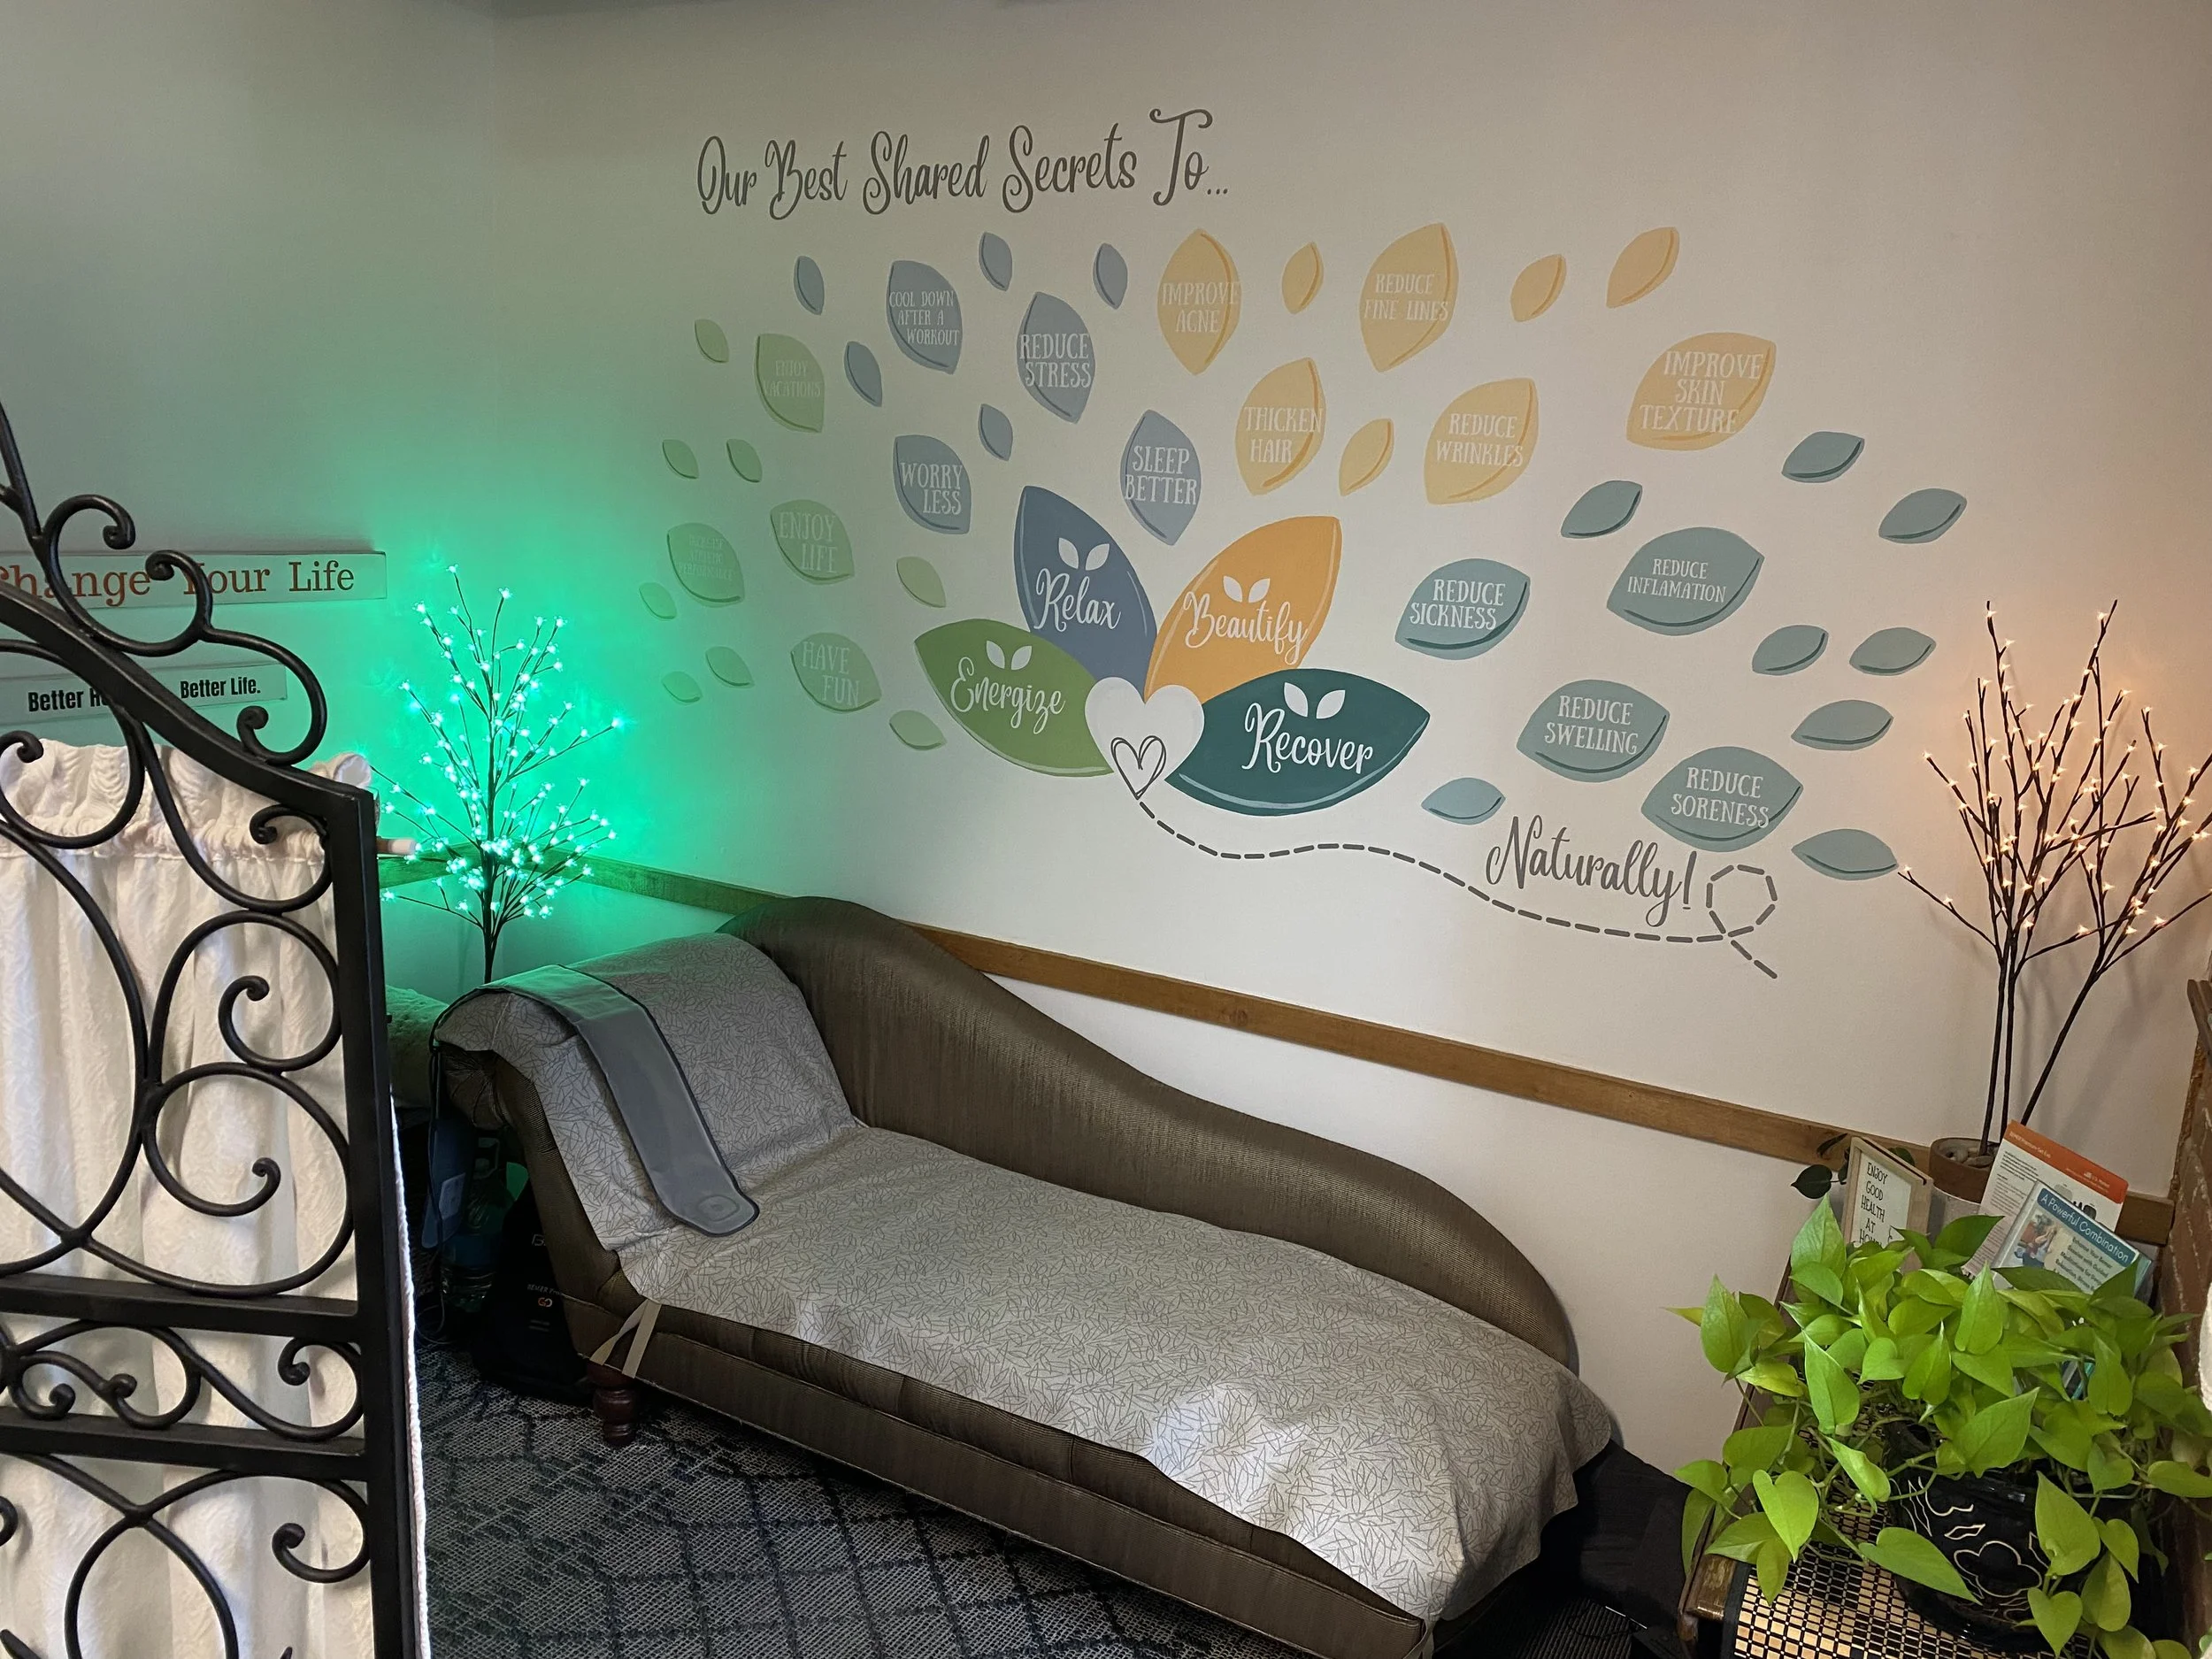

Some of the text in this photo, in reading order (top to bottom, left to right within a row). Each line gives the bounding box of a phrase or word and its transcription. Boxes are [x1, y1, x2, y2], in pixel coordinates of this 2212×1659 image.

[696, 108, 1230, 220] Our Best Shared Secrets To...
[1162, 281, 1240, 305] IMPROVE
[1375, 273, 1435, 295] REDUCE
[889, 290, 955, 308] COOL DOWN
[1363, 299, 1452, 321] FINE LINES
[897, 310, 945, 326] AFTER A
[1175, 310, 1221, 333] ACNE
[906, 328, 960, 346] WORKOUT
[1019, 333, 1089, 360] REDUCE
[1025, 361, 1092, 388] STRESS
[1663, 350, 1764, 380] IMPROVE
[1676, 378, 1725, 406] SKIN
[1243, 406, 1324, 434] THICKEN
[1448, 412, 1518, 439] REDUCE
[1639, 404, 1740, 434] TEXTURE
[1132, 445, 1190, 475] SLEEP
[1249, 438, 1294, 464] HAIR
[1435, 439, 1525, 468] WRINKLES
[900, 462, 964, 490] WORRY
[1125, 473, 1197, 505] BETTER
[922, 488, 962, 516] LESS
[779, 511, 837, 543] ENJOY
[800, 542, 838, 575] LIFE
[1652, 557, 1709, 580] REDUCE
[0, 565, 151, 607] hnge
[288, 559, 355, 592] Life
[1432, 579, 1507, 607] REDUCE
[1627, 575, 1727, 603] INFLAMATION
[1033, 567, 1122, 632] Relax
[1182, 591, 1309, 665] Beautify
[1409, 602, 1498, 631] SICKNESS
[803, 641, 851, 675] HAVE
[27, 689, 85, 712] Better
[180, 679, 227, 699] Better
[230, 676, 262, 695] Life.
[821, 674, 861, 708] FUN
[949, 656, 1067, 735] Energize
[1556, 695, 1634, 726] REDUCE
[1240, 702, 1374, 775] Recover
[1543, 721, 1639, 756] SWELLING
[1686, 766, 1764, 799] REDUCE
[1670, 793, 1770, 829] SORENESS
[1486, 814, 1698, 927] Naturally!
[1866, 1162, 1889, 1185] ENJOY
[1865, 1180, 1884, 1202] GOOD
[1861, 1194, 1886, 1224] HEALTH
[1864, 1217, 1877, 1234] AT
[2039, 1194, 2050, 1205] A
[2048, 1196, 2081, 1227] Powerful
[2080, 1222, 2129, 1263] Combination
